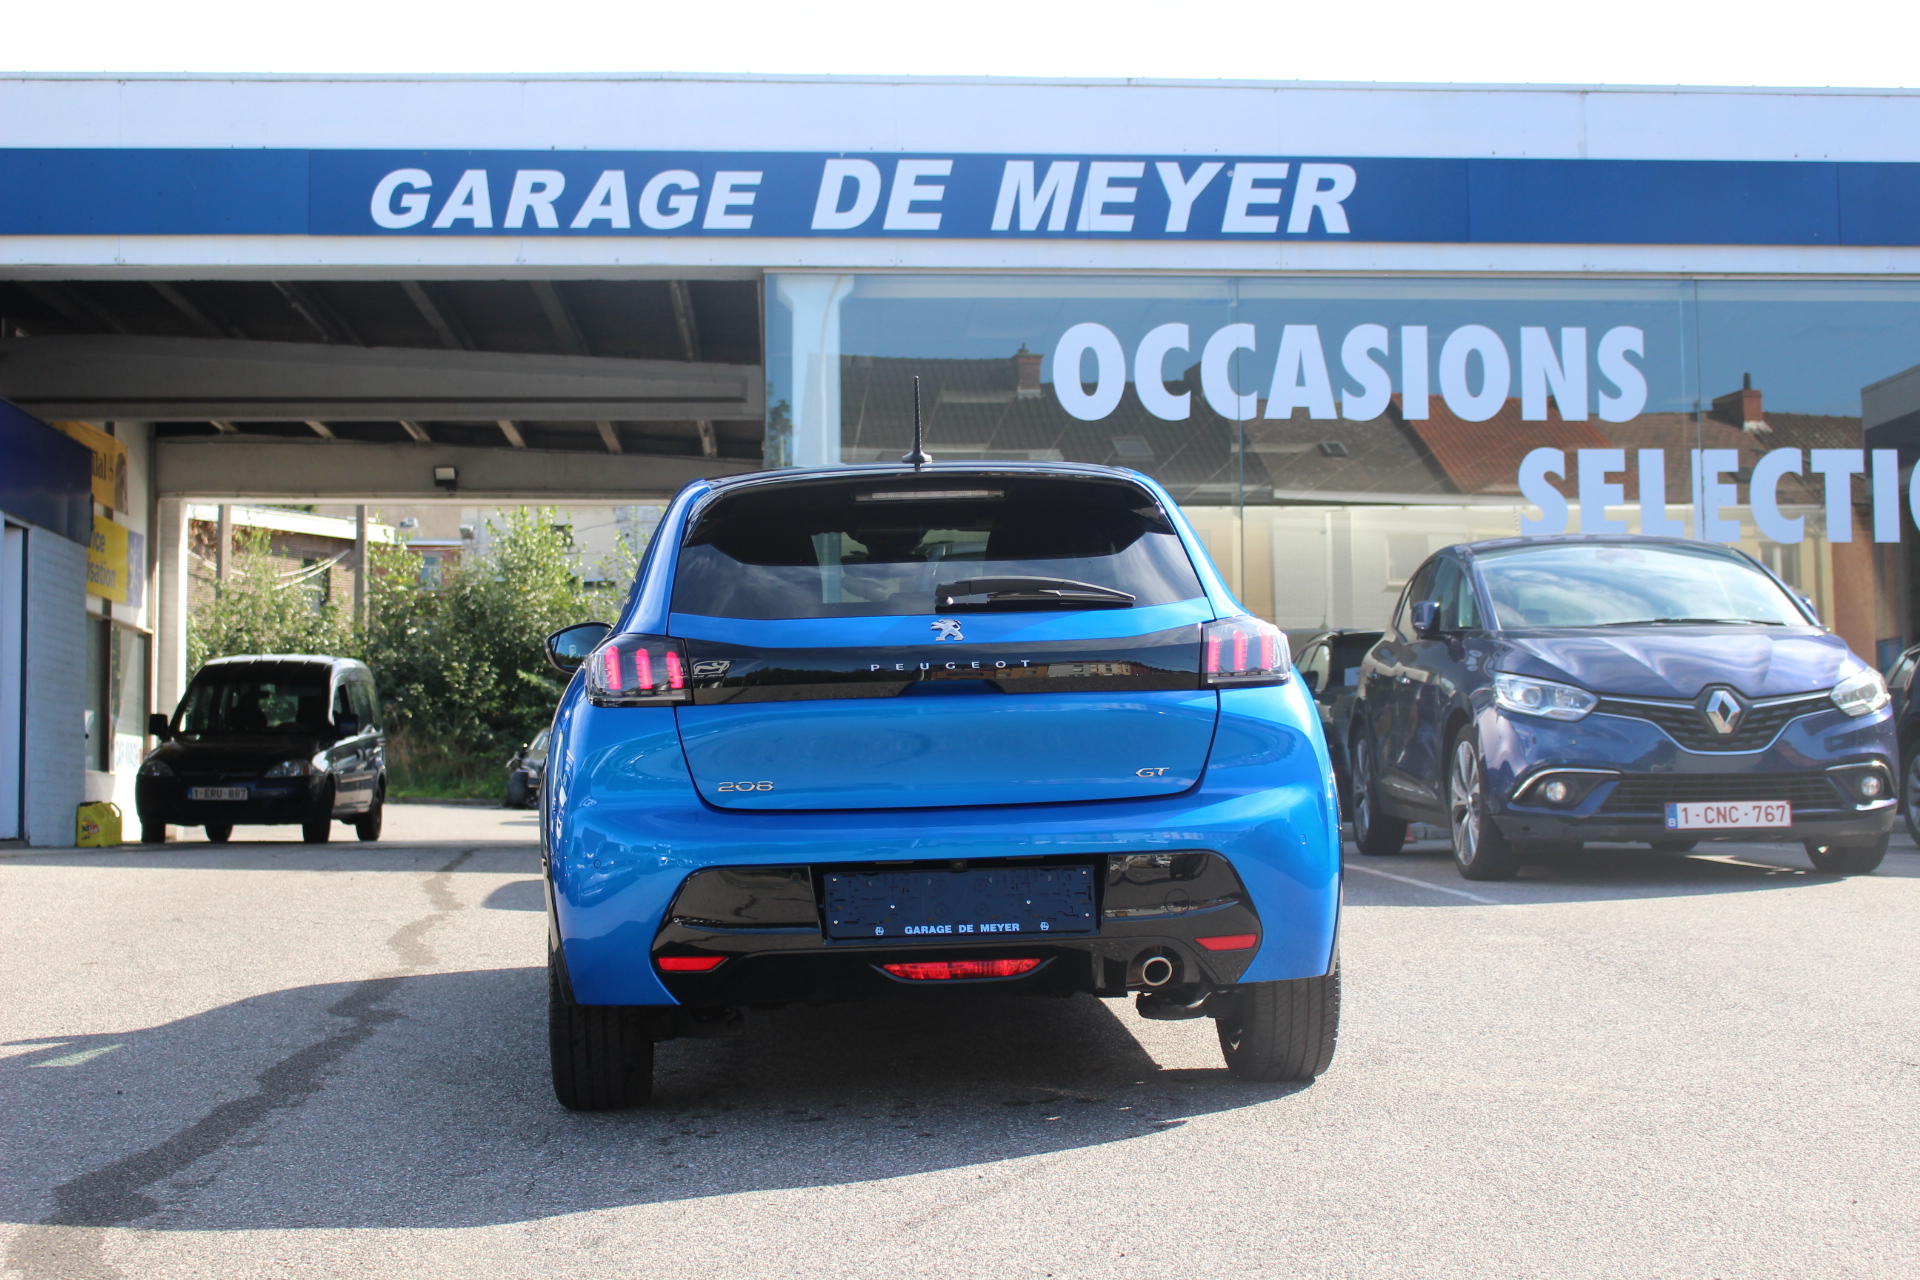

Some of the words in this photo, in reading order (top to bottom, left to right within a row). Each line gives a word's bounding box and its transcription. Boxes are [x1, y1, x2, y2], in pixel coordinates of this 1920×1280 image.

[370, 168, 763, 230] GARAGE
[810, 158, 954, 231] DE
[990, 160, 1357, 234] MEYER
[1052, 322, 1647, 422] OCCASIONS
[1518, 447, 1920, 544] SELECTI
[870, 660, 1030, 672] PEUGEOT
[1135, 767, 1170, 778] GT
[717, 780, 774, 792] 208
[1681, 805, 1786, 824] 1-CNC-767
[904, 925, 952, 935] GARAGE
[958, 924, 974, 933] DE
[980, 923, 1020, 932] MEYER
